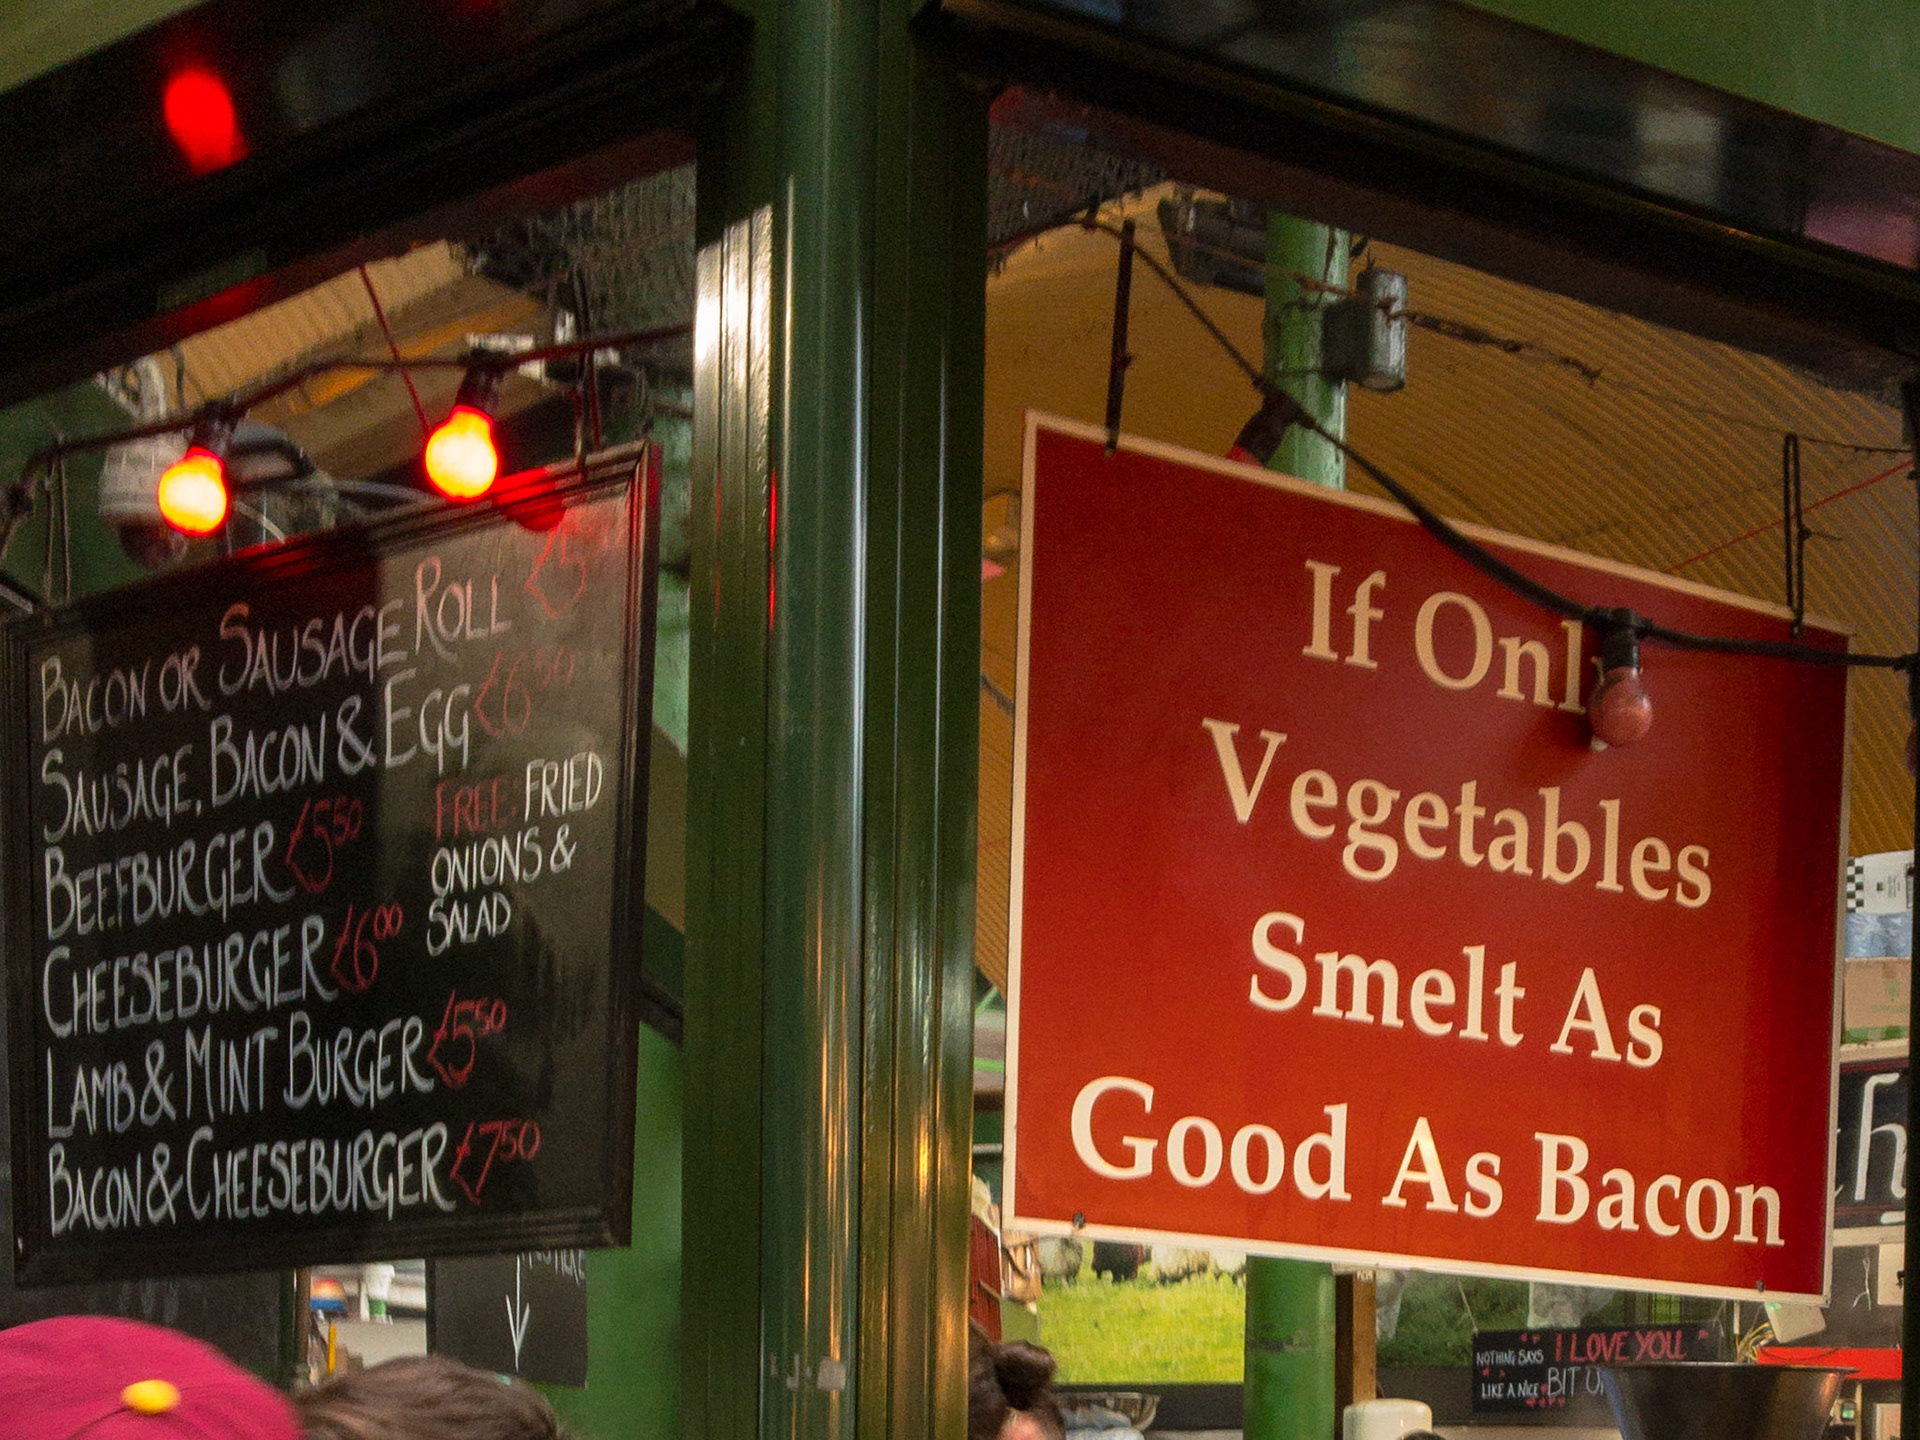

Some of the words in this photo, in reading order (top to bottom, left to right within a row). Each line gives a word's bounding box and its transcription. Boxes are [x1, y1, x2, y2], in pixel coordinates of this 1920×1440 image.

[41, 655, 150, 745] BACON
[159, 645, 211, 712] OR
[219, 600, 410, 697] SAUSAGE
[415, 555, 512, 661] ROLL
[1302, 558, 1387, 670] If
[1415, 590, 1645, 751] Onl
[210, 714, 326, 809] BACON
[337, 694, 377, 776] &
[384, 666, 471, 777] EGG
[524, 751, 603, 823] FRIED
[431, 825, 543, 898] ONIONS
[550, 823, 577, 873] &
[1201, 717, 1712, 908] Vegetables
[44, 820, 295, 940] BEEFBURGER
[426, 891, 512, 957] SALAD
[43, 915, 338, 1038] CHEESEBURGER
[1248, 910, 1526, 1049] Smelt
[1549, 966, 1664, 1070] As
[47, 1047, 136, 1138] LAMB
[140, 1039, 177, 1126] &
[185, 1023, 279, 1122] MINT
[283, 1011, 434, 1110] BURGER
[49, 1143, 142, 1238] BACON
[146, 1143, 183, 1225] &
[186, 1122, 456, 1221] CHEESEBURGER
[1070, 1074, 1353, 1204] Good
[1380, 1115, 1504, 1220] As
[1532, 1130, 1786, 1247] Bacon
[1476, 1349, 1516, 1367] NOTHING
[1518, 1348, 1545, 1366] SAYS
[1555, 1332, 1562, 1362] I
[1568, 1330, 1629, 1363] LOVE
[1634, 1329, 1688, 1361] YOU
[1481, 1382, 1505, 1399] LIKE
[1506, 1382, 1517, 1398] A
[1517, 1380, 1540, 1398] NICE
[1547, 1365, 1582, 1397] BIT
